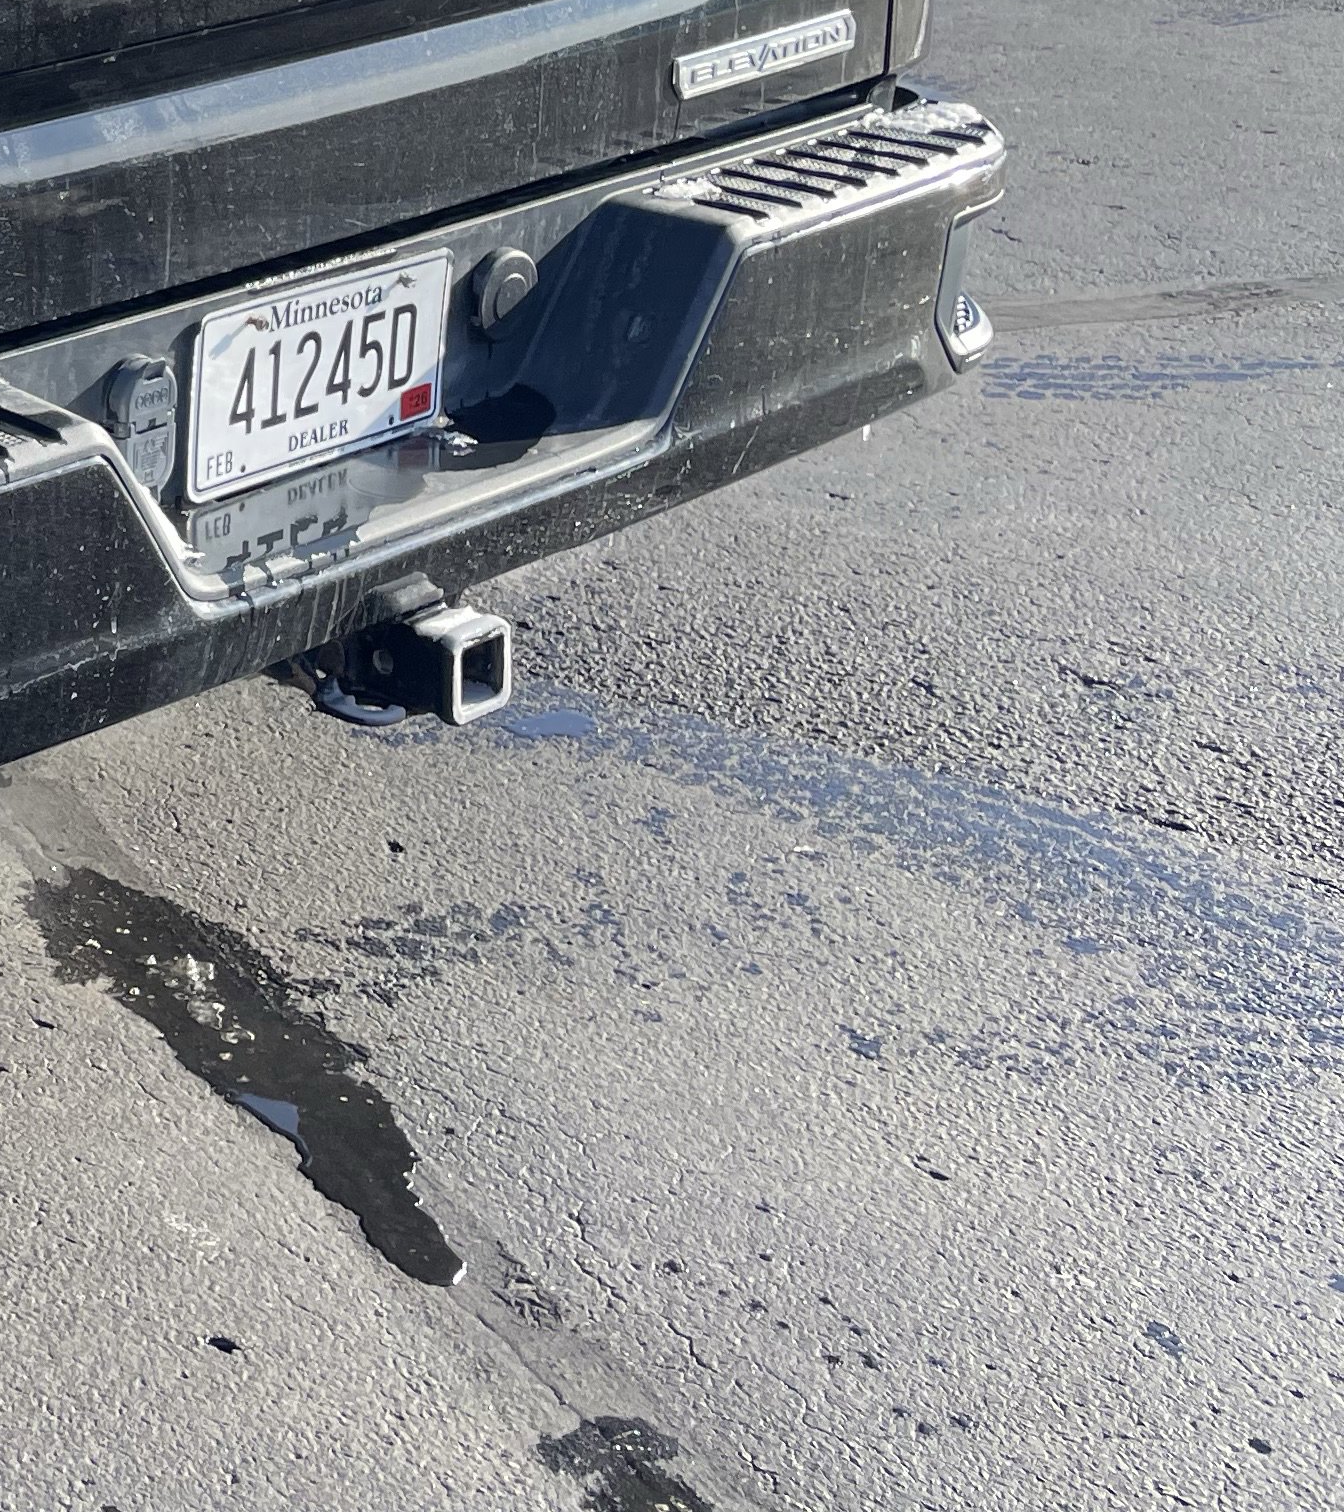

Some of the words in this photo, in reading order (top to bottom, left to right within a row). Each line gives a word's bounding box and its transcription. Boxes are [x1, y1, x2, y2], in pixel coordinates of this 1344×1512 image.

[690, 20, 846, 85] ELEVATION
[268, 284, 383, 333] Minnesota
[228, 302, 418, 435] 41245D
[288, 419, 350, 452] DEALER
[206, 449, 233, 481] FEB
